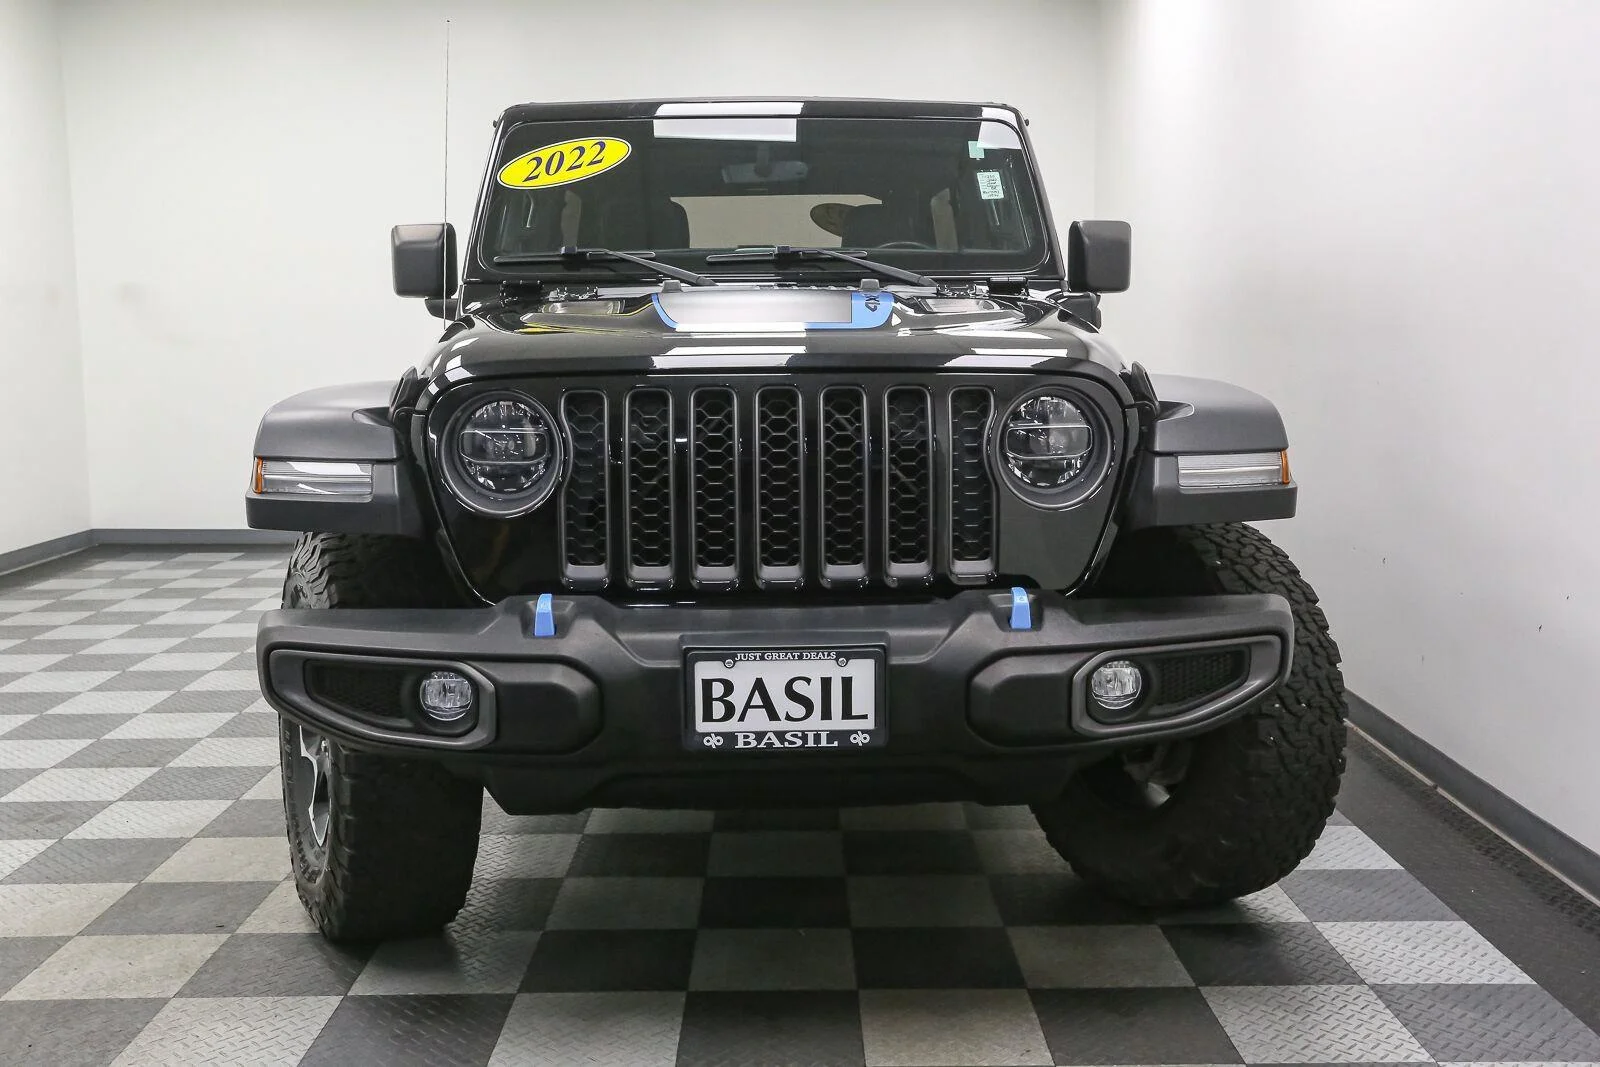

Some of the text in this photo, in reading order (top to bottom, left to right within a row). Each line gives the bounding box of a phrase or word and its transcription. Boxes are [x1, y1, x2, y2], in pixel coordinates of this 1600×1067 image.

[522, 141, 606, 182] 2022
[735, 651, 837, 661] JUST GREAT DEALS
[701, 676, 869, 723] BASIL
[734, 731, 839, 748] BASIL
